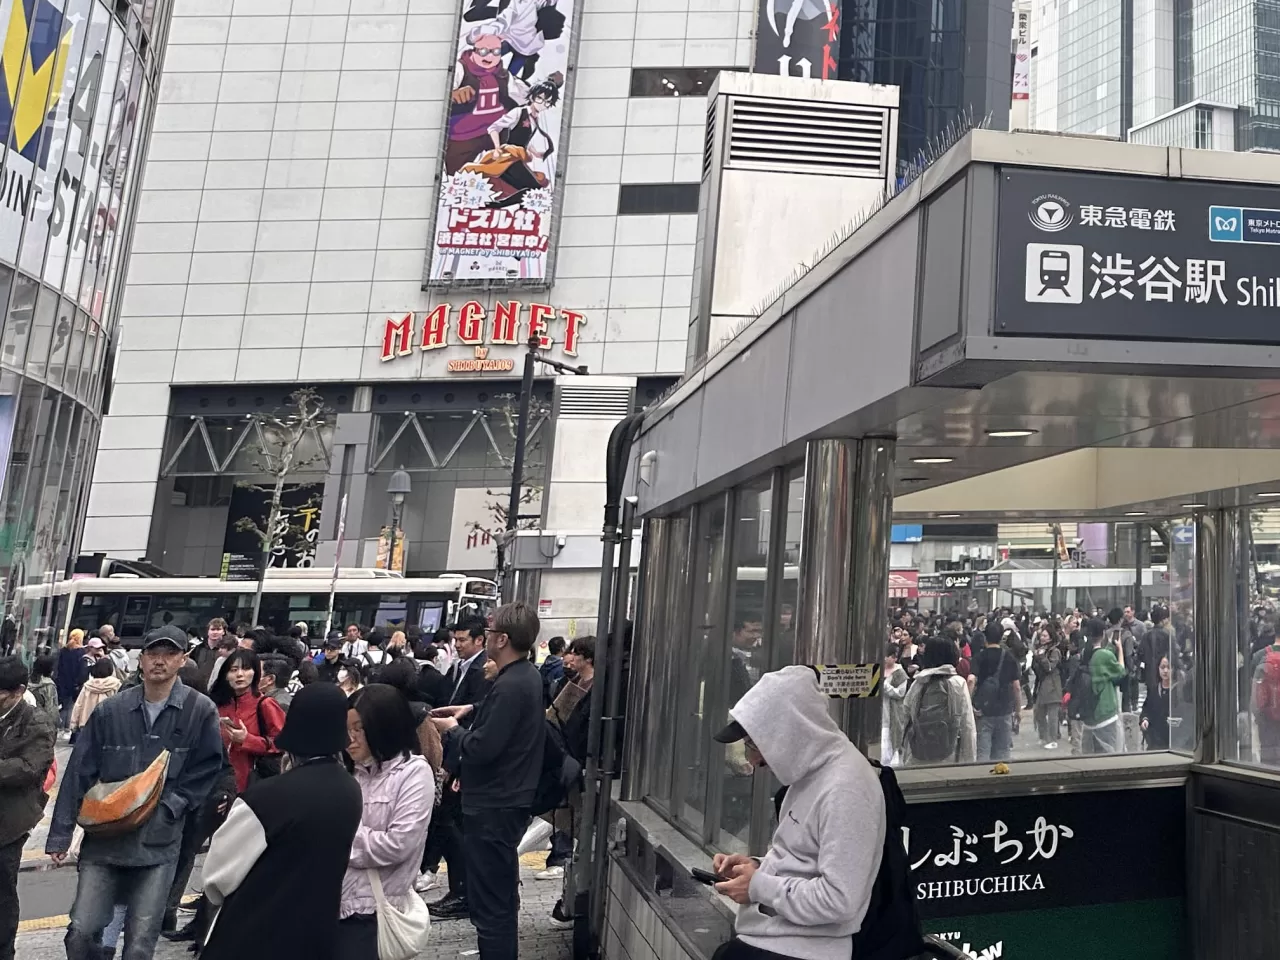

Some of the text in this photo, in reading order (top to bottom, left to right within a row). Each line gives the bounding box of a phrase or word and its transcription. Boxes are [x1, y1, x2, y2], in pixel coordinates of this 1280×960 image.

[1031, 193, 1070, 207] TOKYU RAILWAYS
[448, 208, 537, 231] ドズル社
[1079, 204, 1176, 232] 東急電鉄
[491, 249, 541, 258] SHIBUYA109
[1089, 251, 1228, 304] 渋谷駅
[380, 300, 588, 362] MAGNET
[447, 360, 514, 372] SHIBUYA109
[900, 816, 1074, 870] しぶちか
[916, 873, 1045, 900] SHIBUCHIKA
